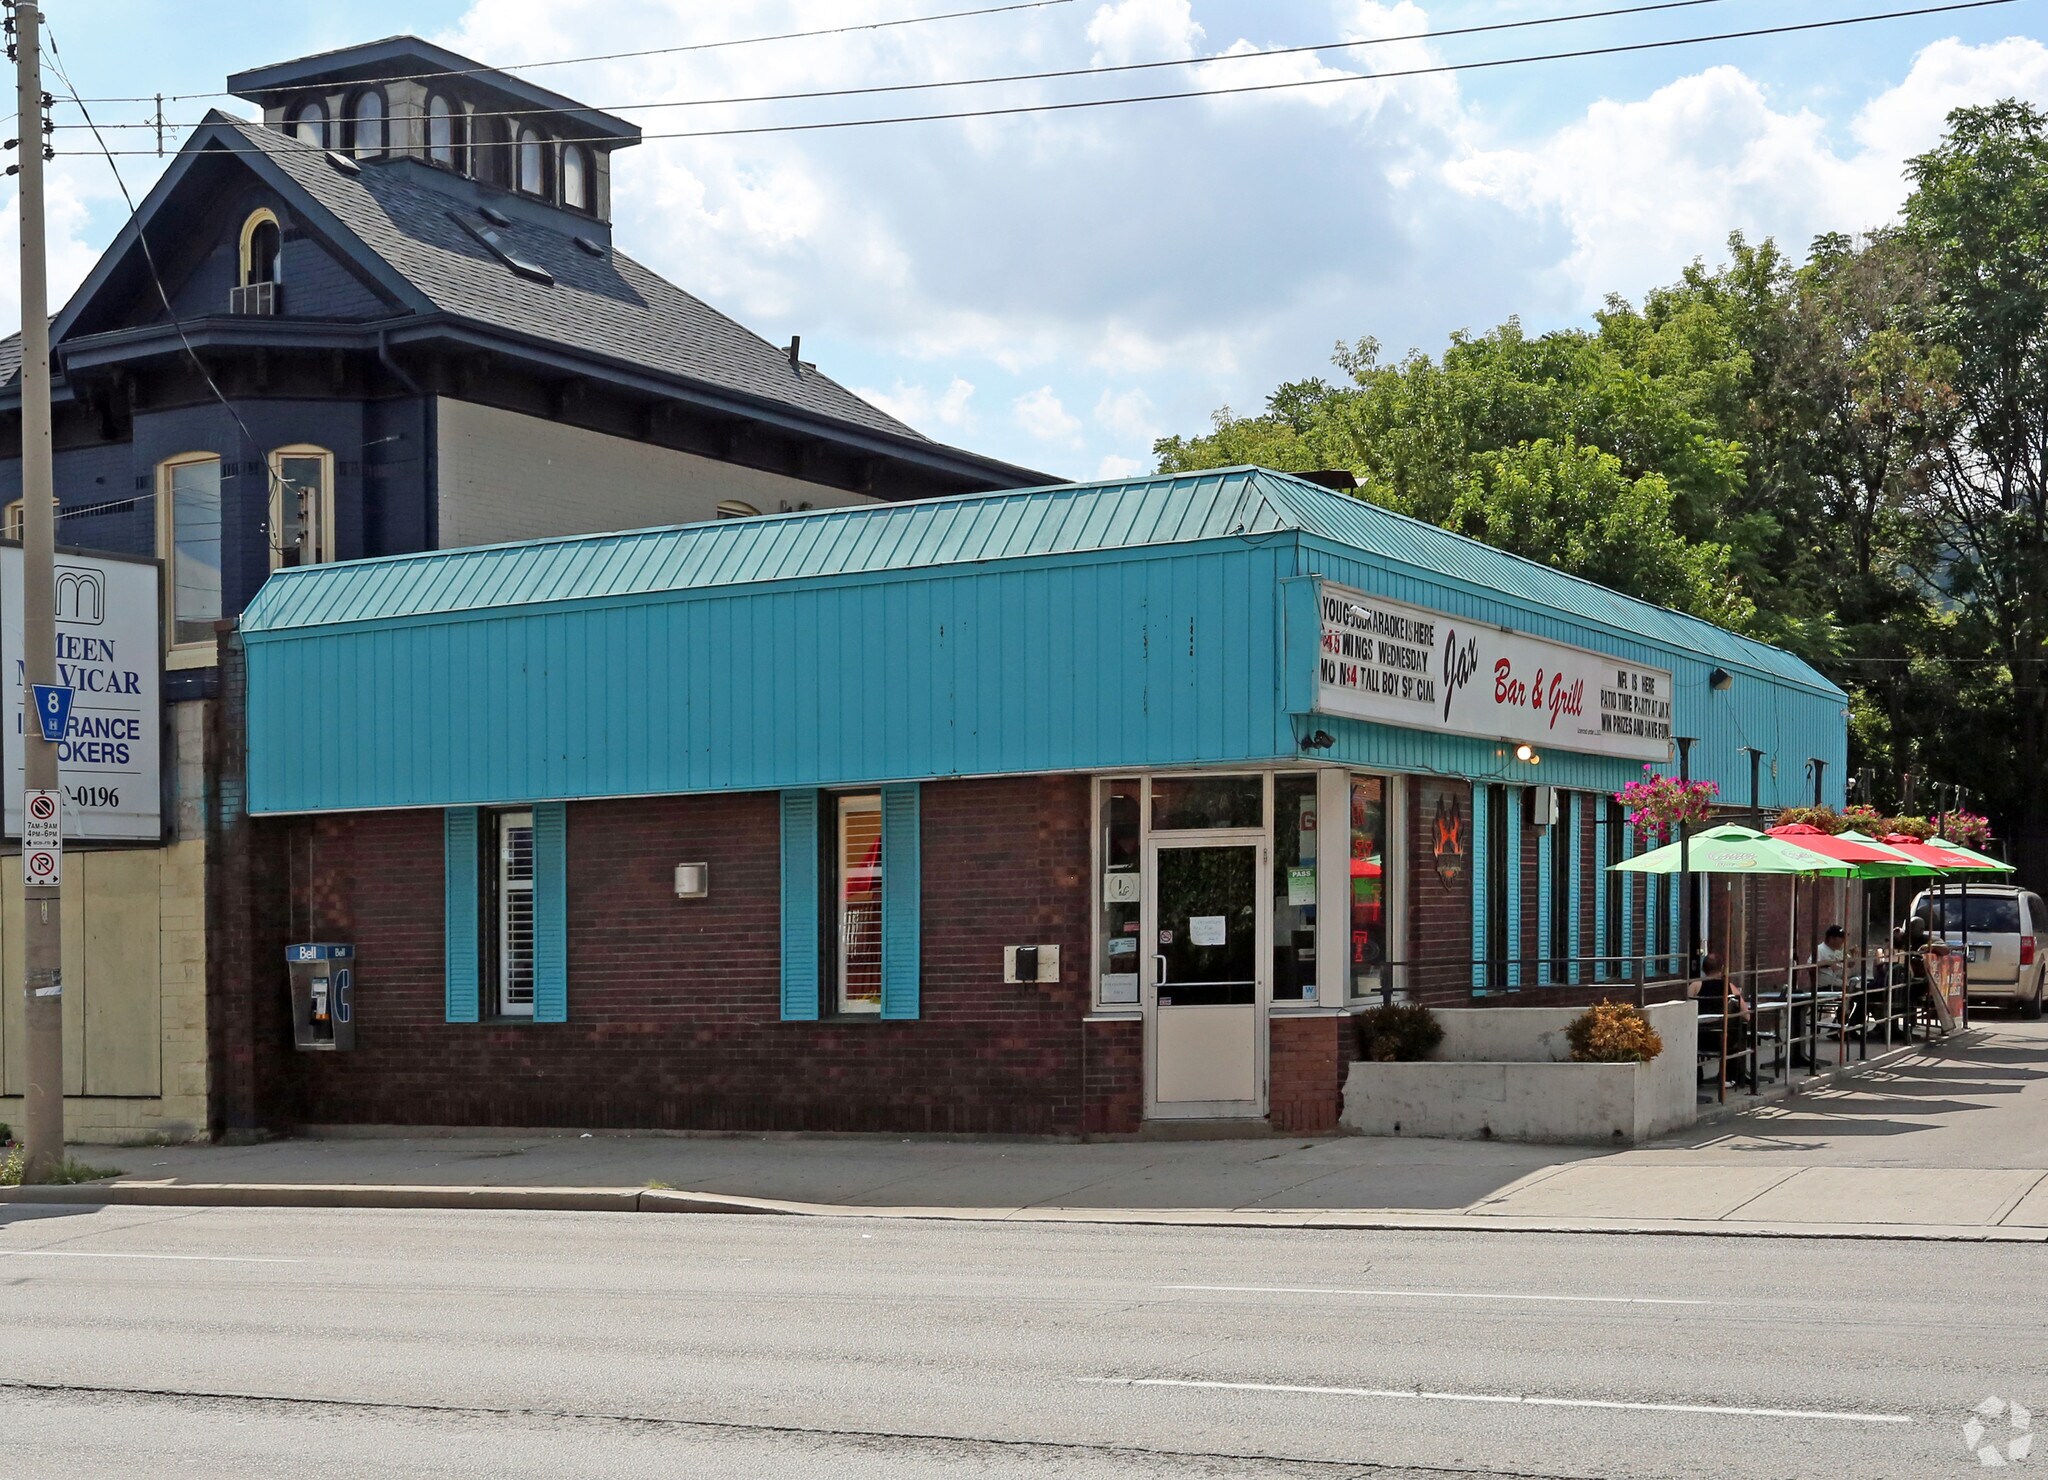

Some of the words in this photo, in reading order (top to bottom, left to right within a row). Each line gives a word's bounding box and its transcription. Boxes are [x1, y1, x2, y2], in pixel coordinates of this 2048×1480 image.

[1342, 633, 1373, 660] WINGS
[1378, 640, 1428, 672] WEDNESDAY
[1361, 667, 1379, 692] TALL
[1382, 671, 1399, 695] BOY
[1402, 675, 1435, 702] SPCIAL
[1443, 629, 1478, 723] Jax
[1617, 670, 1627, 689] NFL
[1631, 673, 1637, 691] IS
[1641, 675, 1655, 695] HERE
[48, 692, 59, 713] 8
[1494, 657, 1526, 706] Bar
[1532, 668, 1543, 709] &
[1548, 672, 1584, 730] Grill
[1600, 689, 1617, 709] PATIO
[1618, 693, 1632, 712] TIME
[1612, 715, 1633, 735] PRIZES
[1633, 718, 1644, 737] AND
[1644, 719, 1658, 739] HAVE
[300, 946, 316, 959] Bell
[335, 948, 345, 957] Bell
